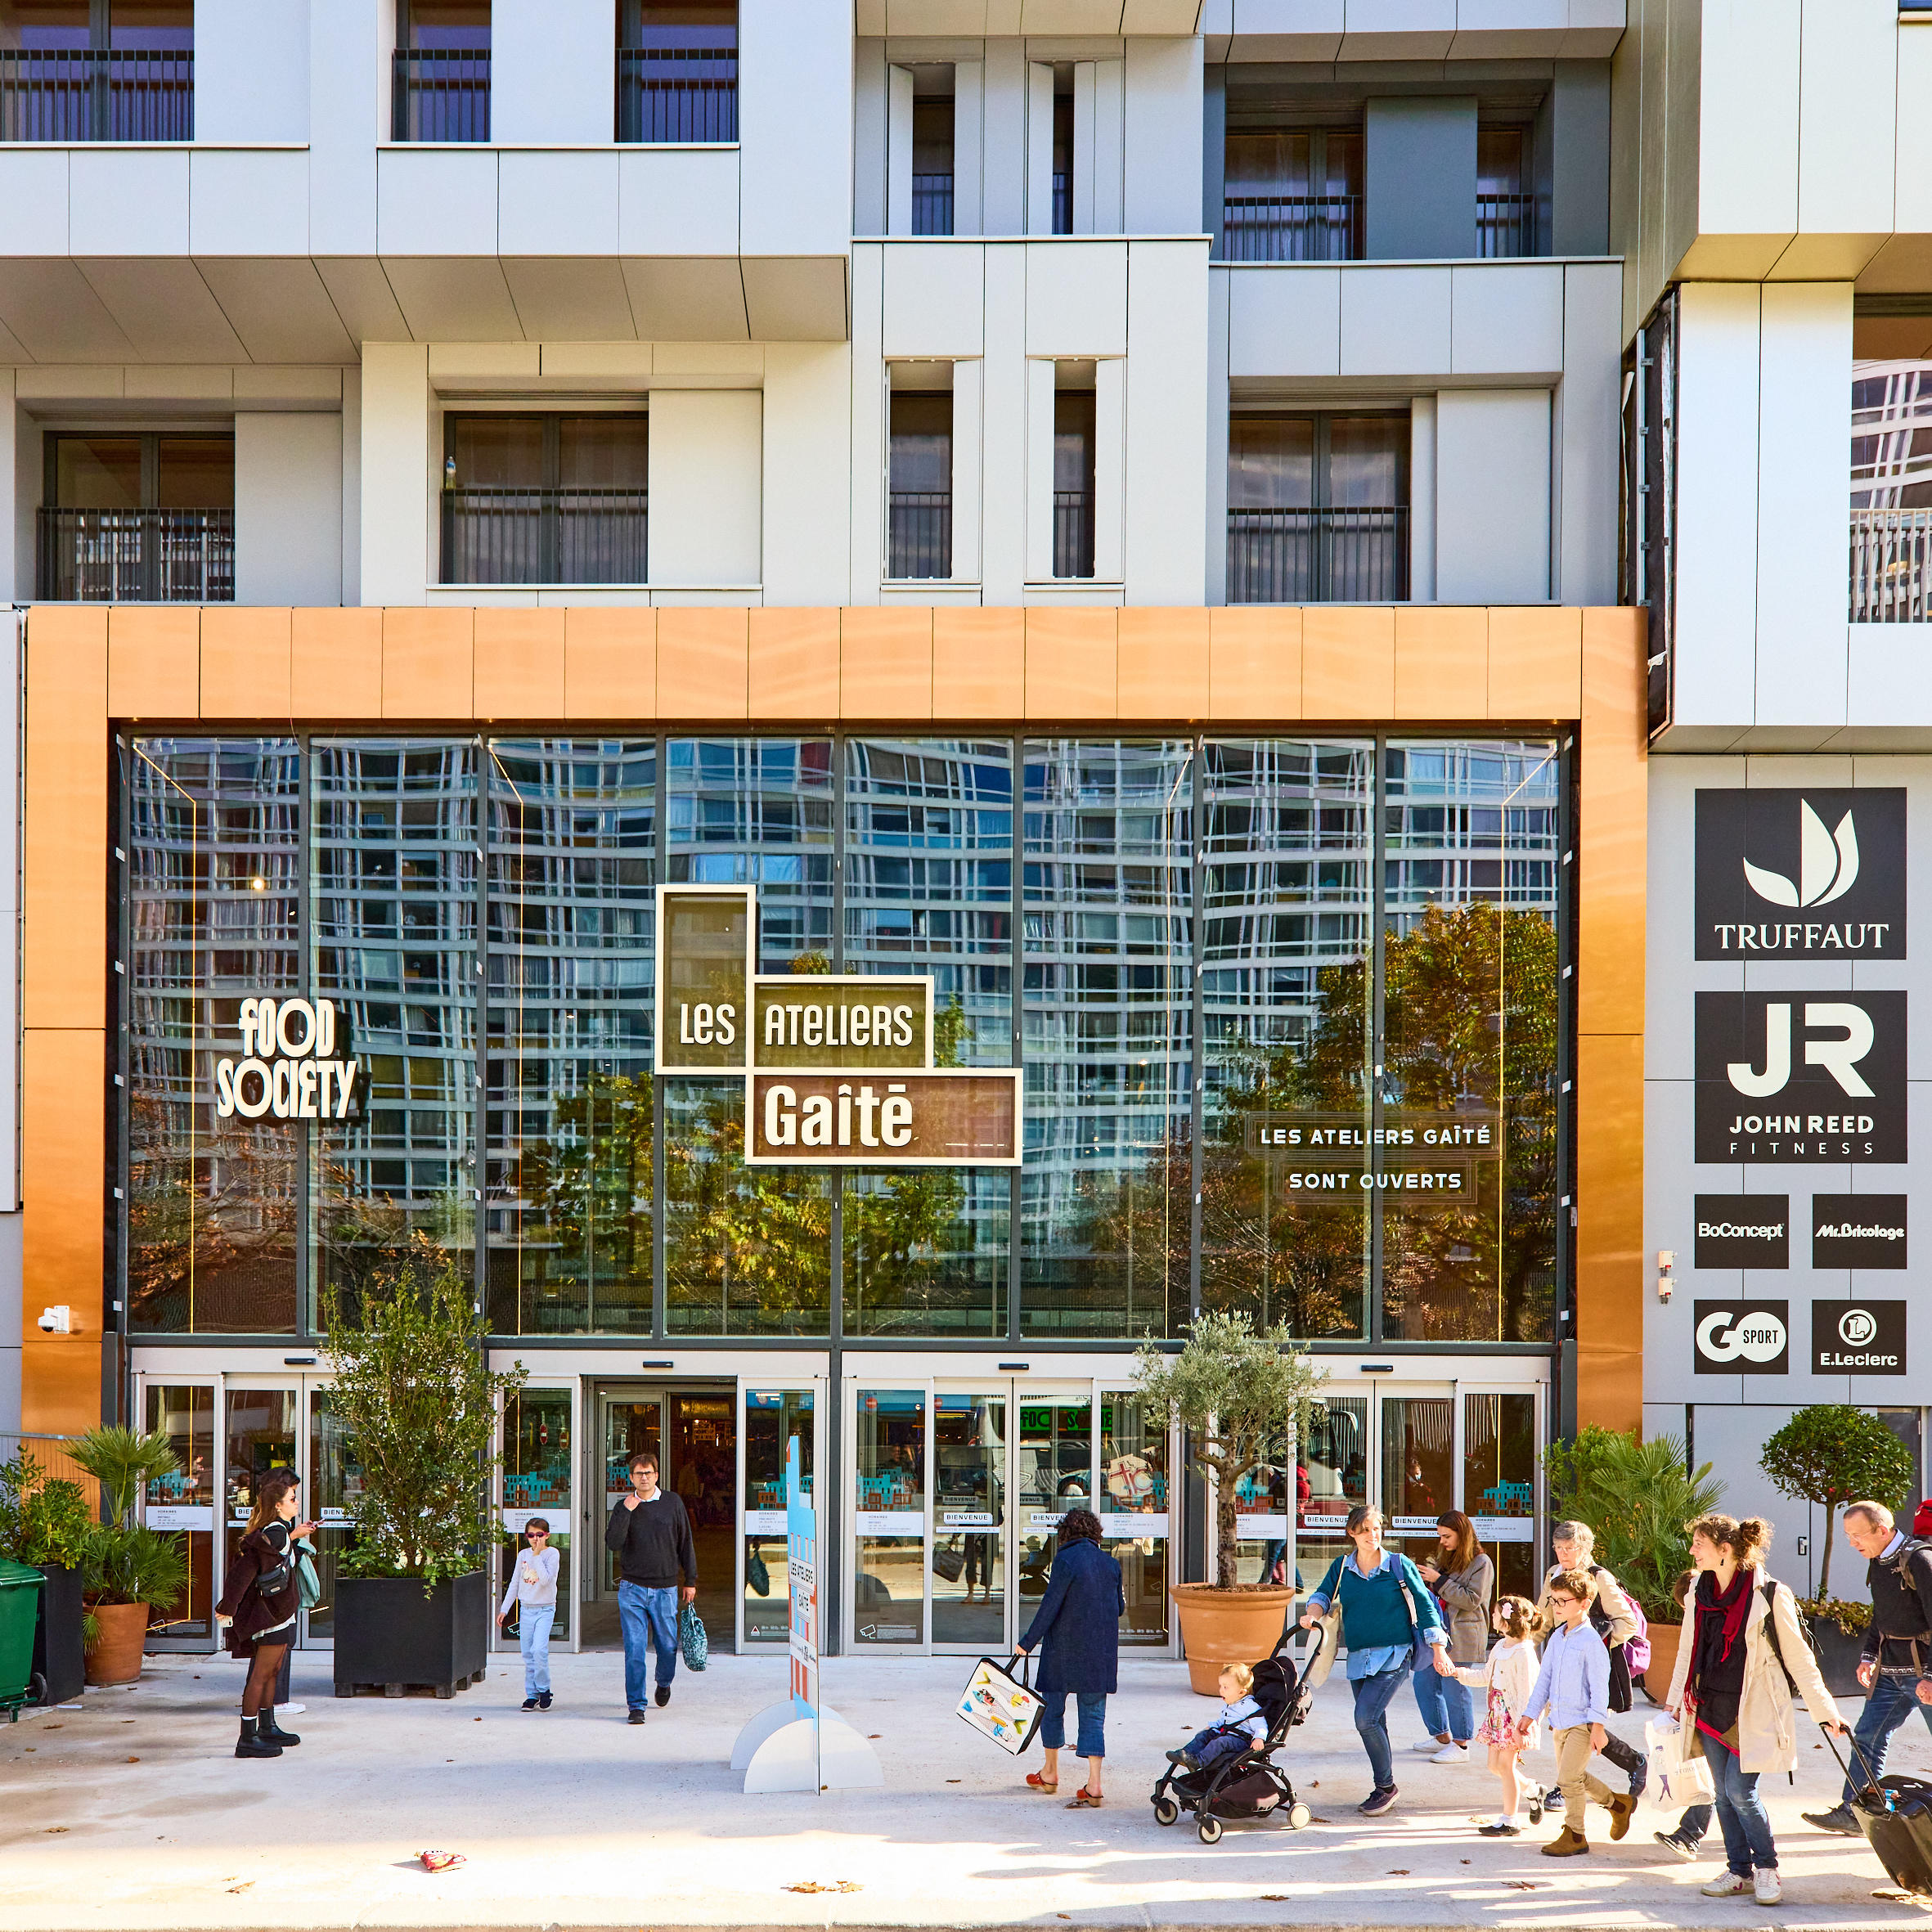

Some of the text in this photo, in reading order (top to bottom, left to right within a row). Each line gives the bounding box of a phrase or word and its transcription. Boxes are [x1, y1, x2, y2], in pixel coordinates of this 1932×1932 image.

[1714, 923, 1889, 950] TRUFFAUT
[1727, 1003, 1876, 1098] JR
[217, 1058, 357, 1119] SOCIETY
[1729, 1115, 1874, 1134] JOHN REED
[1260, 1129, 1301, 1144] LES
[1310, 1129, 1414, 1145] ATELIERS
[1730, 1142, 1873, 1155] FITNESS
[1289, 1173, 1462, 1189] SONT OUVERTS
[1698, 1222, 1784, 1241] BoConcept
[1696, 1311, 1786, 1363] GO
[1743, 1329, 1779, 1344] SPORT
[1820, 1352, 1898, 1366] E.Leclerc
[798, 1564, 814, 1584] ATELIERS
